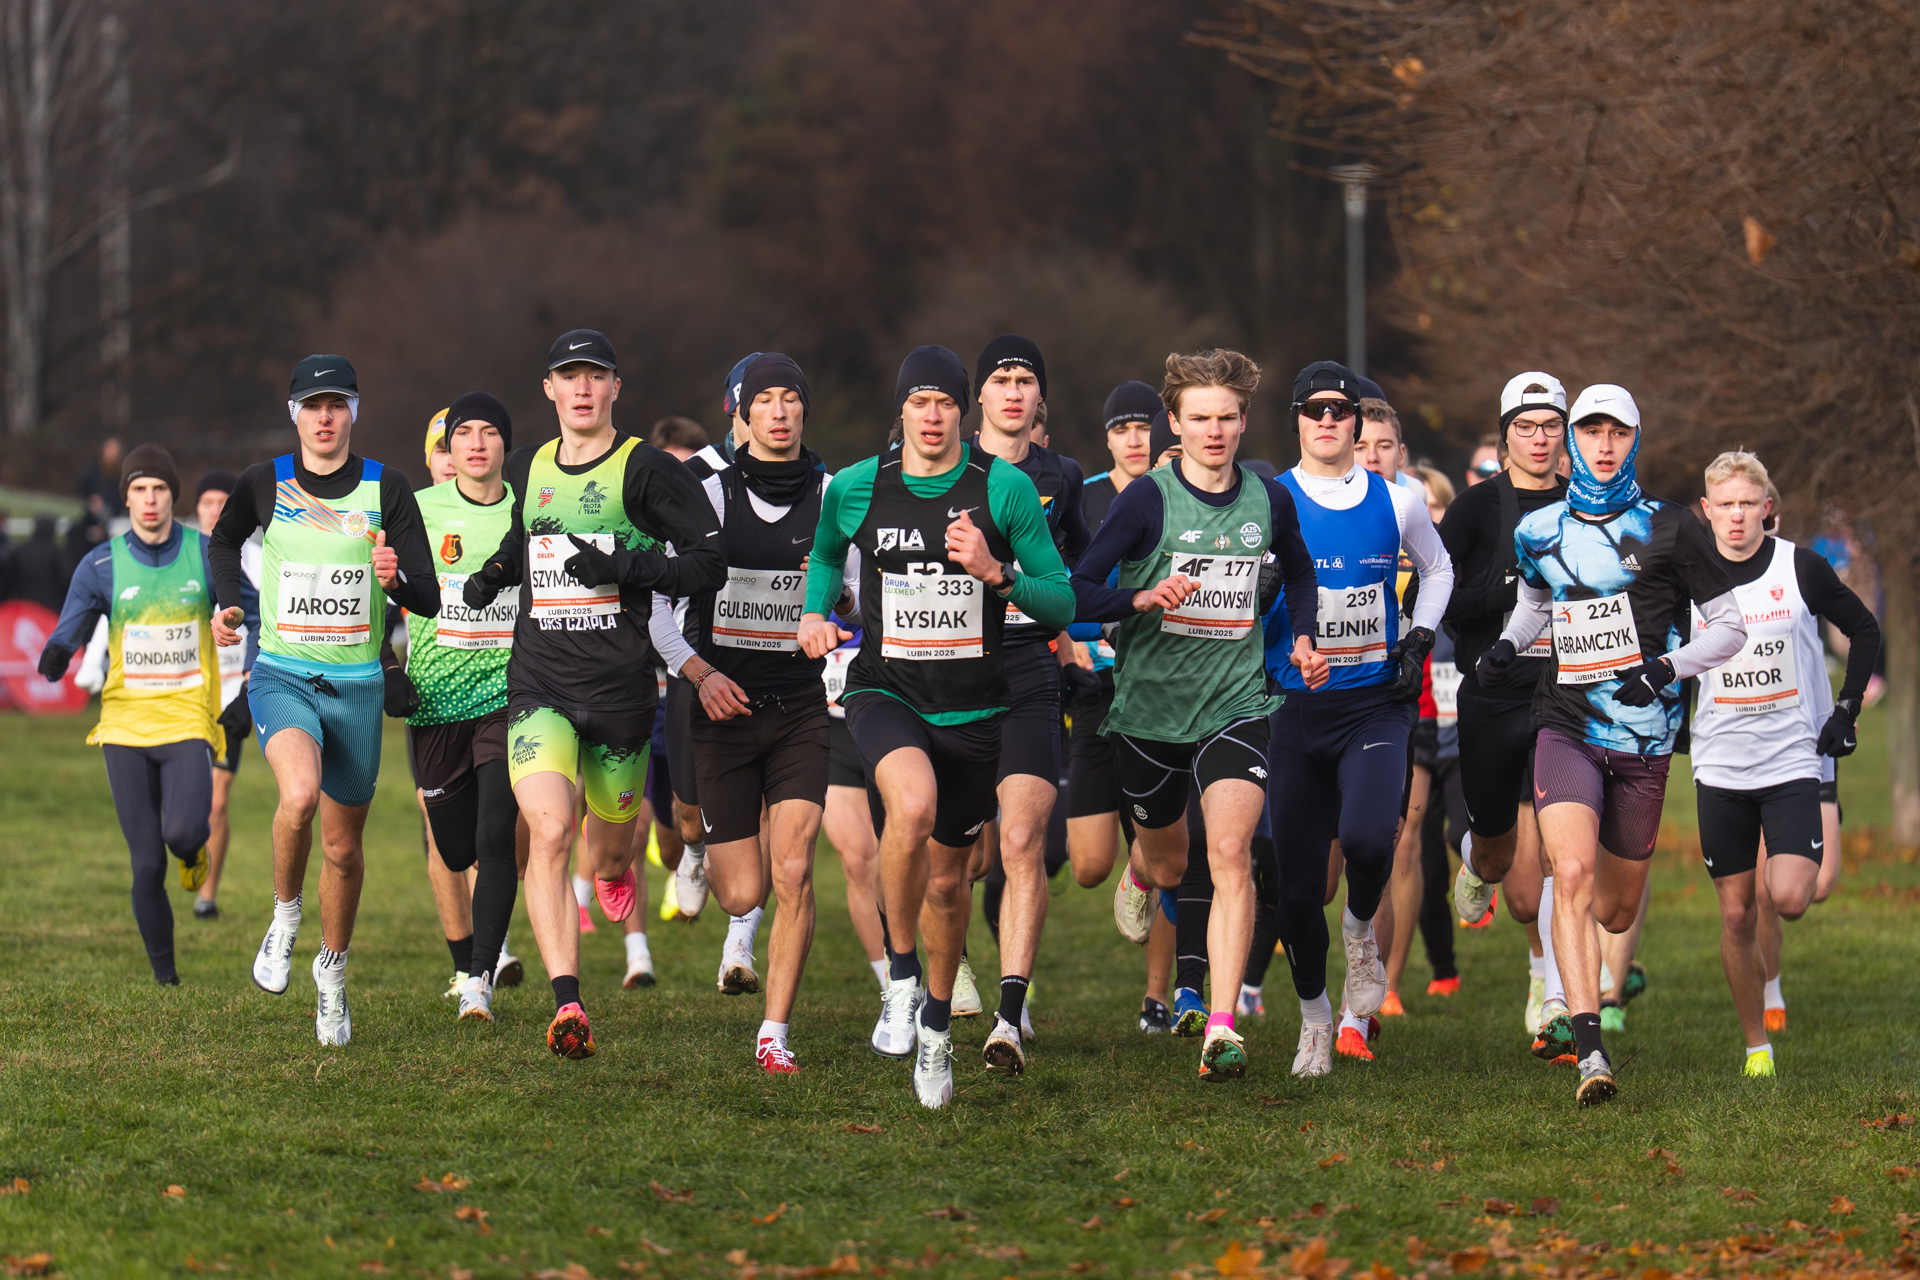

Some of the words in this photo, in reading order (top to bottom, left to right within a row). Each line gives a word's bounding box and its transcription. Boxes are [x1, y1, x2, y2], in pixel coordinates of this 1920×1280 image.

[1179, 530, 1203, 543] 4F
[1177, 558, 1214, 577] 4F
[1224, 561, 1255, 577] 177
[1314, 558, 1330, 569] TL
[1619, 563, 1642, 571] adidas
[292, 571, 316, 579] MUNDO
[331, 570, 364, 585] 699
[771, 575, 802, 590] 697
[448, 580, 464, 591] RC
[884, 579, 910, 588] GRUPA
[884, 586, 915, 595] LUXMED
[937, 580, 974, 596] 333
[287, 597, 361, 615] JAROSZ
[1346, 589, 1377, 608] 239
[718, 600, 803, 622] GULBINOWICZ
[1587, 600, 1622, 620] 224
[566, 614, 617, 631] CZAPLA
[895, 610, 968, 628] ŁYSIAK
[165, 626, 192, 641] 375
[1188, 628, 1213, 636] LUBIN
[1213, 629, 1233, 637] 2025
[1316, 617, 1379, 638] LEJNIK
[736, 639, 760, 648] LUBIN
[1558, 627, 1634, 654] ABRAMCZYK
[1753, 640, 1784, 657] 459
[126, 648, 197, 666] BONDARUK
[1575, 673, 1596, 682] LUBIN
[1597, 670, 1615, 678] 202
[1722, 668, 1782, 688] BATOR
[1758, 703, 1776, 711] 2025
[518, 755, 536, 766] TEAM
